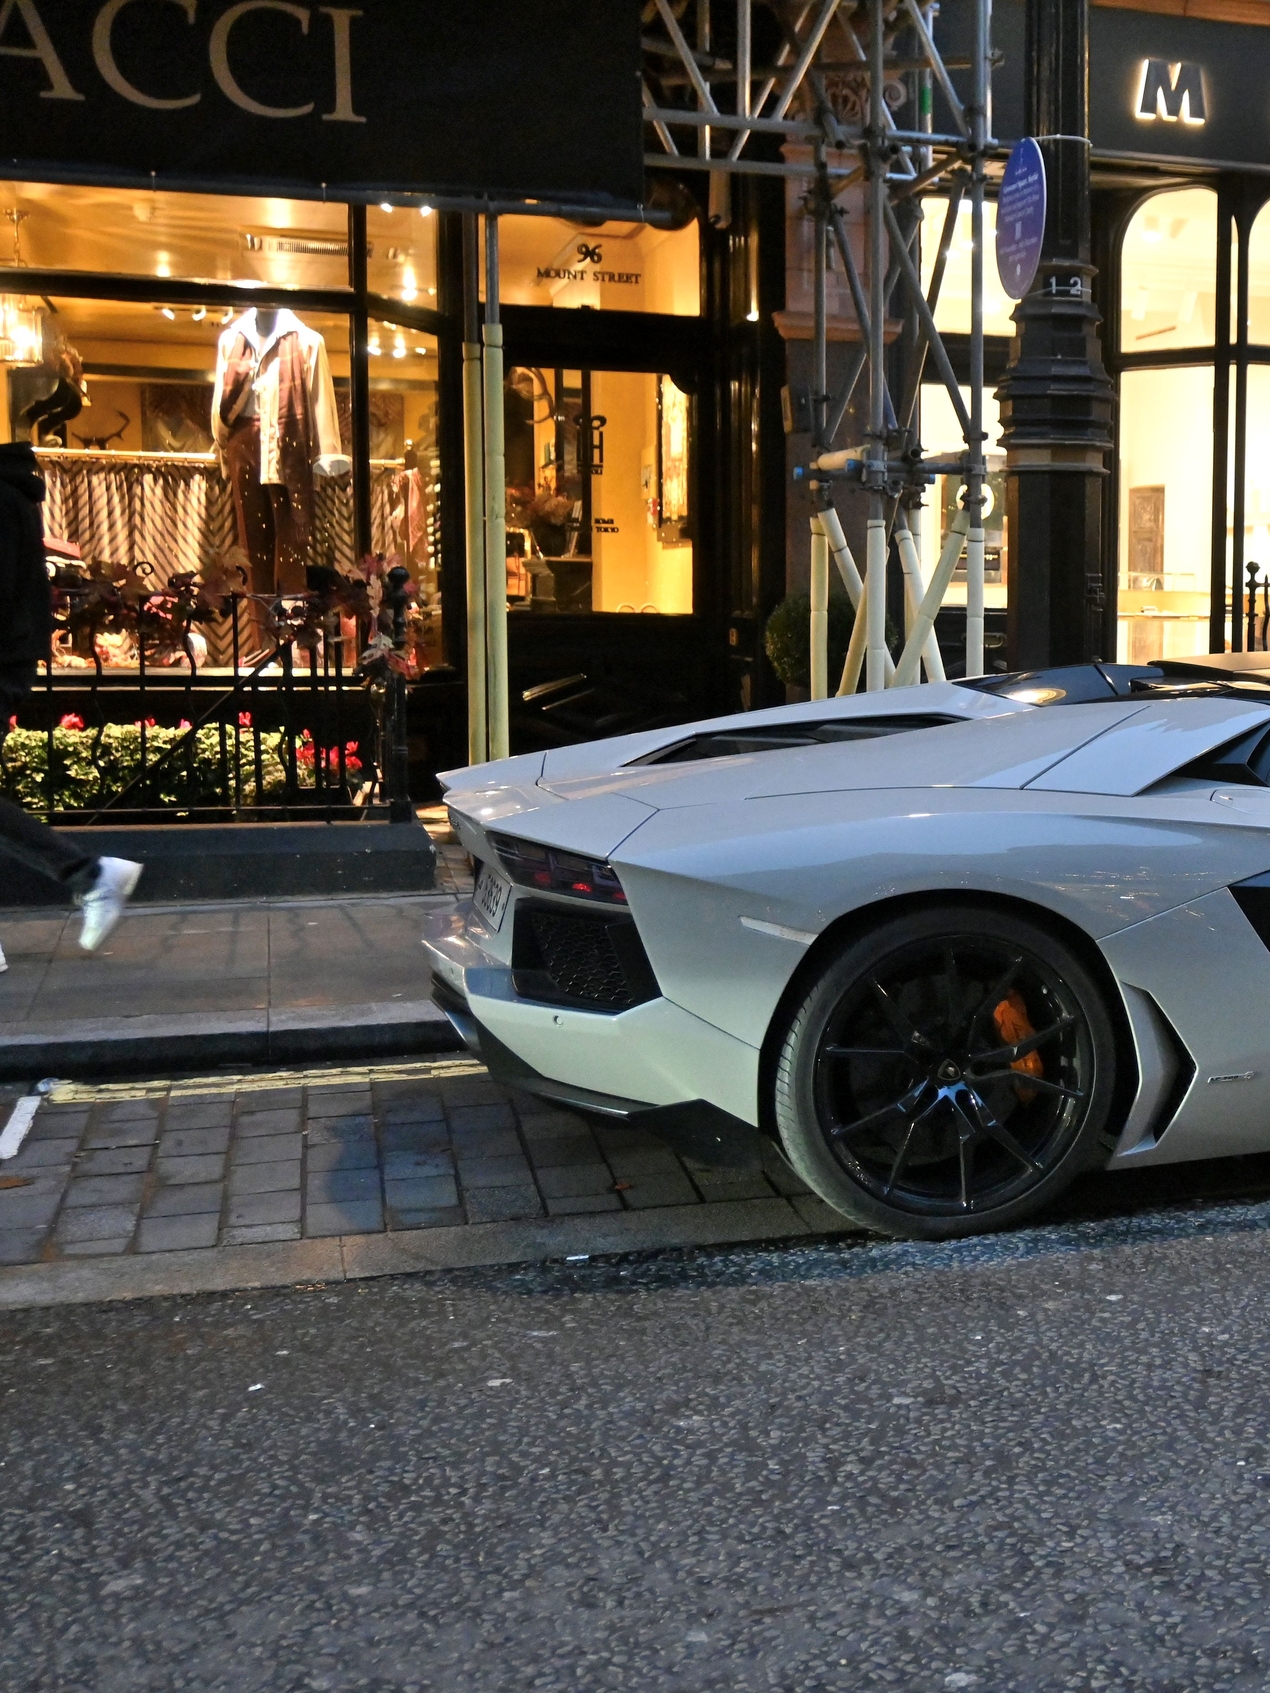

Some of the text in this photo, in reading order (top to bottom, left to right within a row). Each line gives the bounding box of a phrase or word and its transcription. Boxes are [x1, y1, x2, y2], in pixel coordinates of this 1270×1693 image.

[0, 0, 367, 122] ACCI
[577, 243, 602, 263] 96
[537, 267, 641, 284] MOUNT STREET
